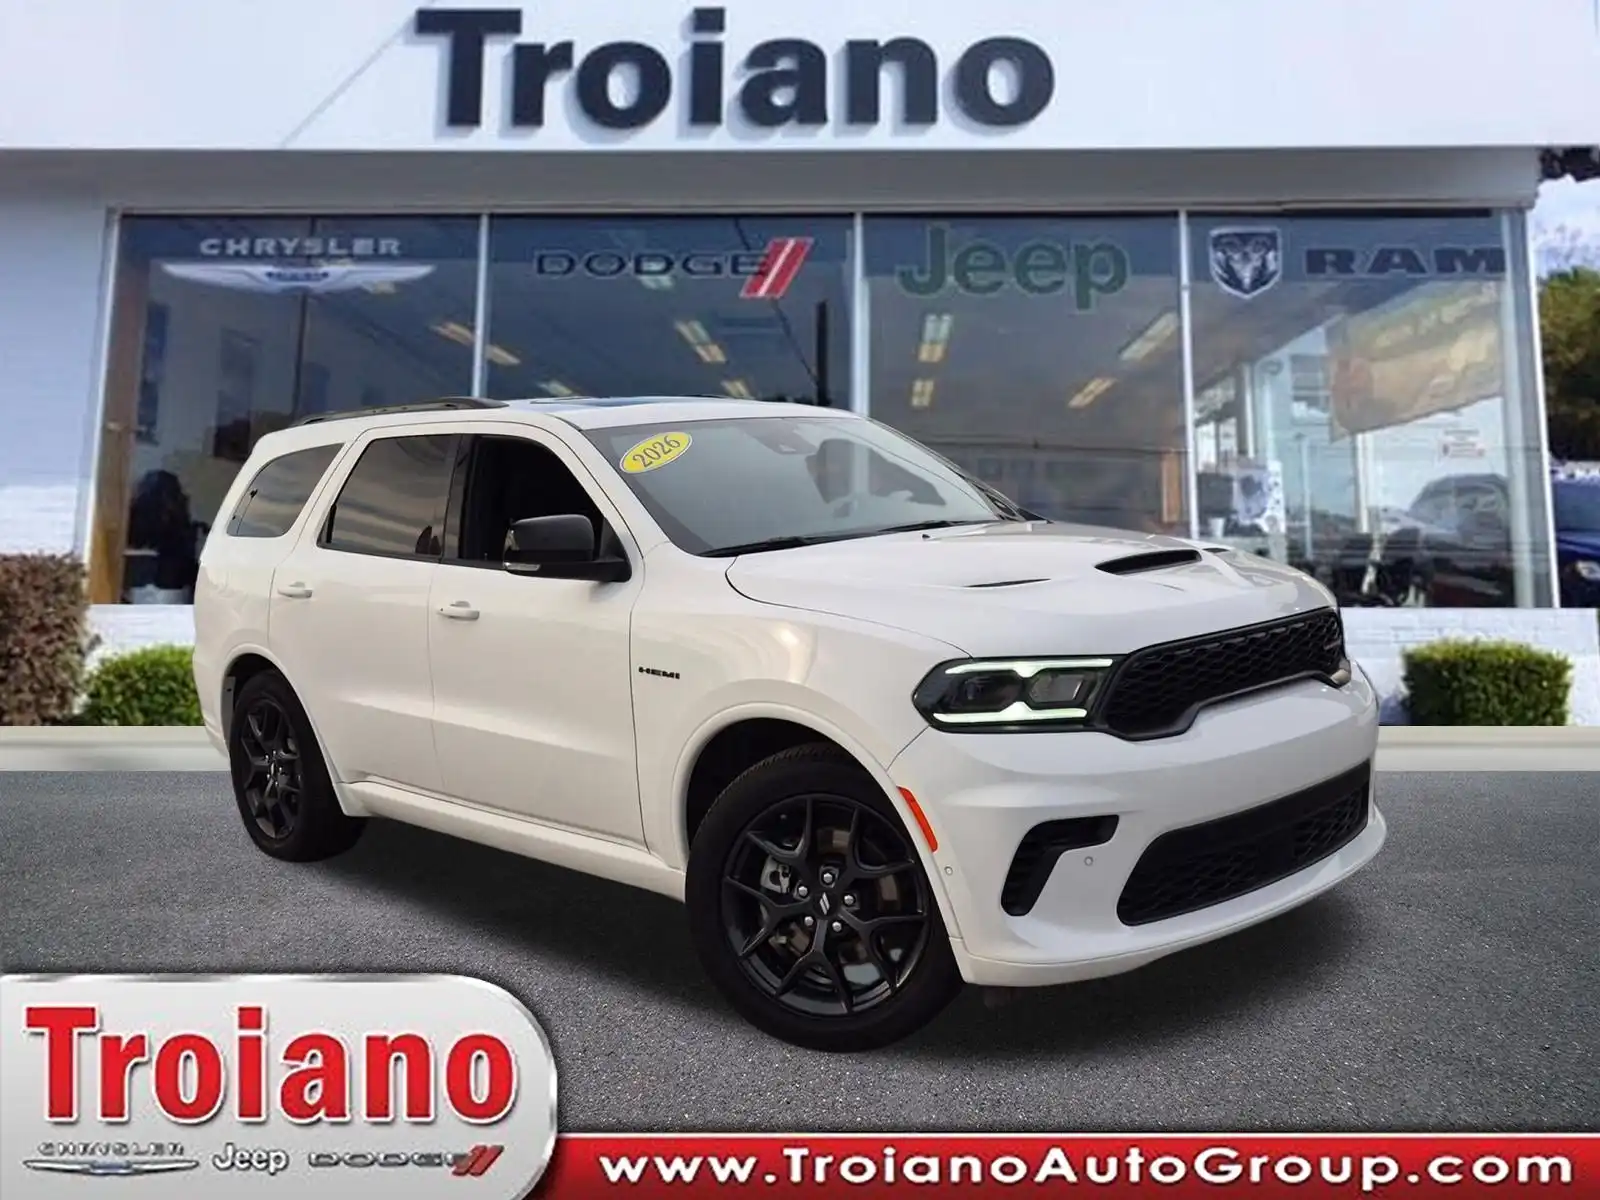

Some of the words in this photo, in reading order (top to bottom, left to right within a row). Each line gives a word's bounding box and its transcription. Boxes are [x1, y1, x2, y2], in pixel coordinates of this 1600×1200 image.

[416, 7, 1055, 129] Troiano
[200, 237, 400, 255] CHRYSLER
[1304, 246, 1506, 275] RAM
[535, 251, 767, 277] DODGE
[899, 225, 1128, 309] Jeep
[632, 435, 680, 467] 2026
[638, 666, 680, 680] HEMI
